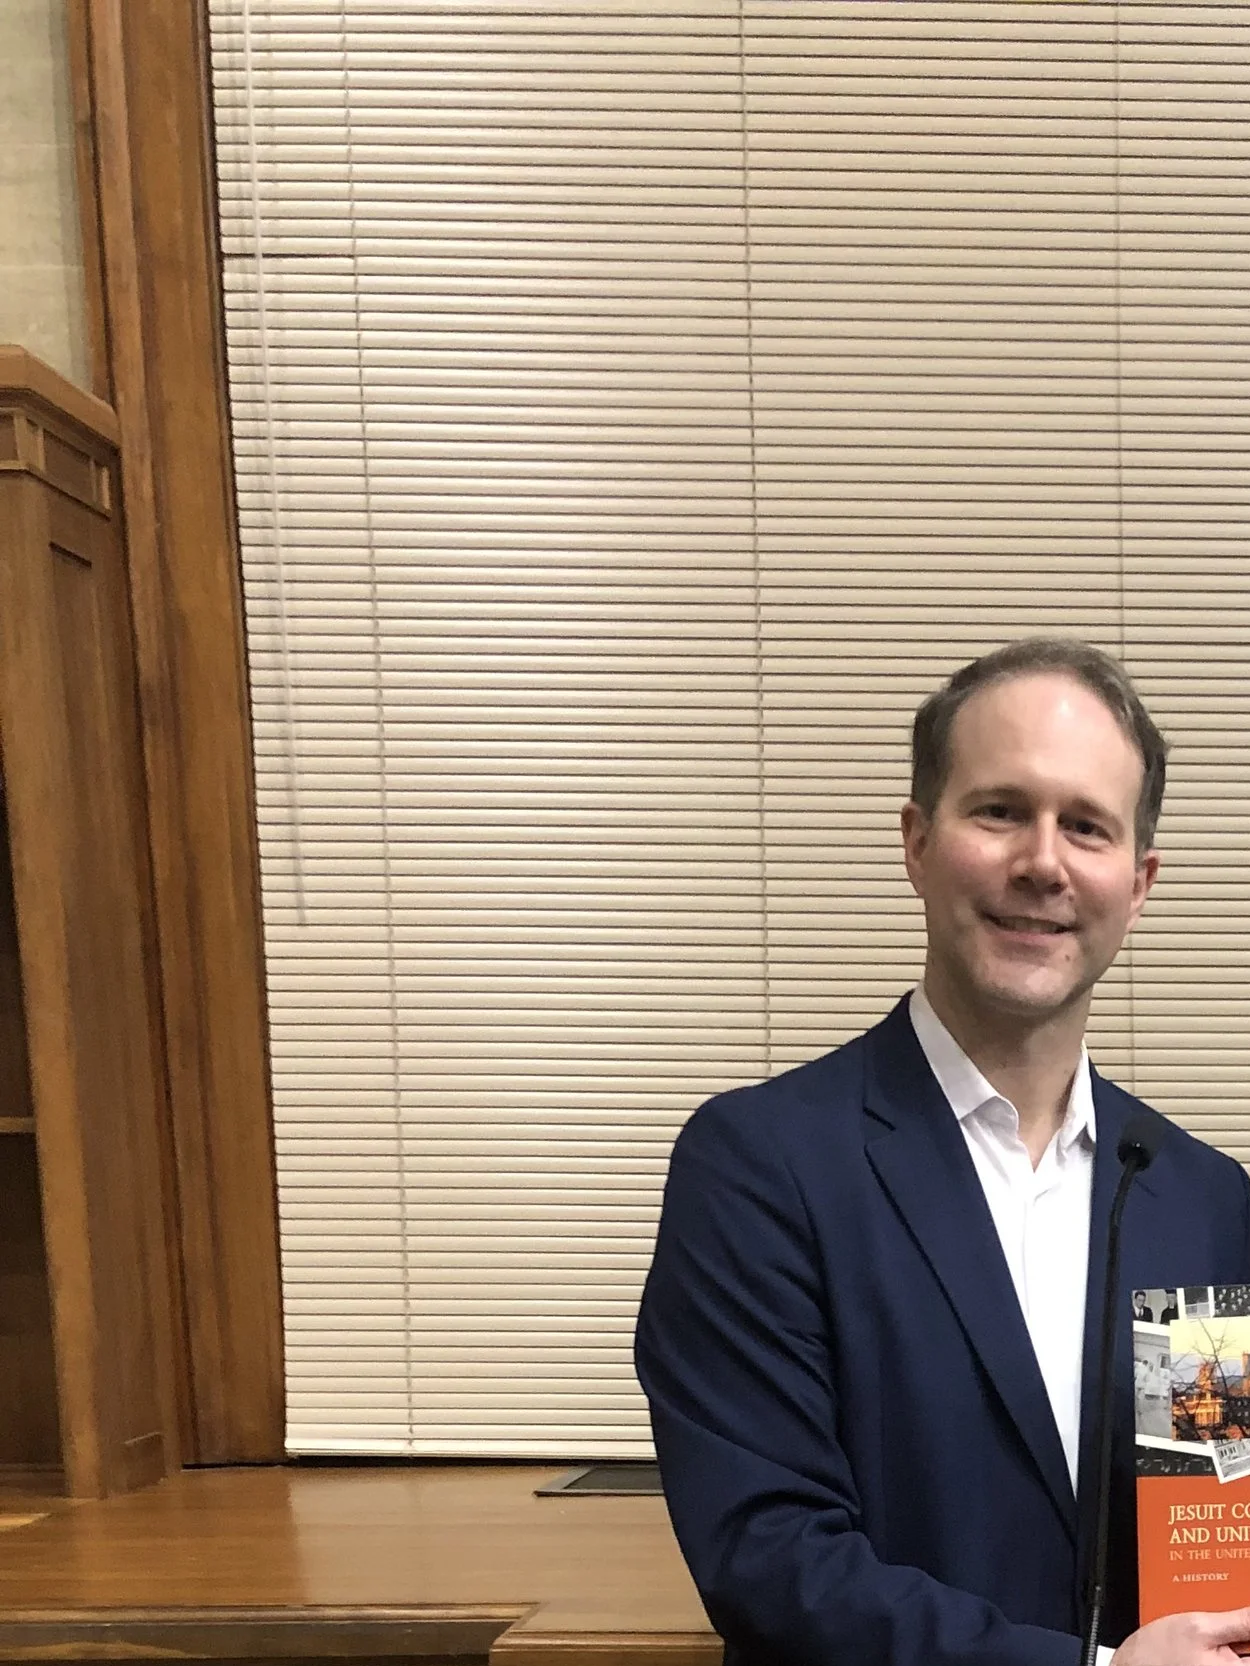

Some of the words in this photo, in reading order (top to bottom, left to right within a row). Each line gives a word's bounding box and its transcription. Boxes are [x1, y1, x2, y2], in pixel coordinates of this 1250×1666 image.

[1168, 1504, 1226, 1525] JESUIT
[1169, 1527, 1210, 1544] AND
[1169, 1550, 1183, 1561] IN
[1187, 1549, 1212, 1560] THE
[1183, 1573, 1229, 1582] HISTORY
